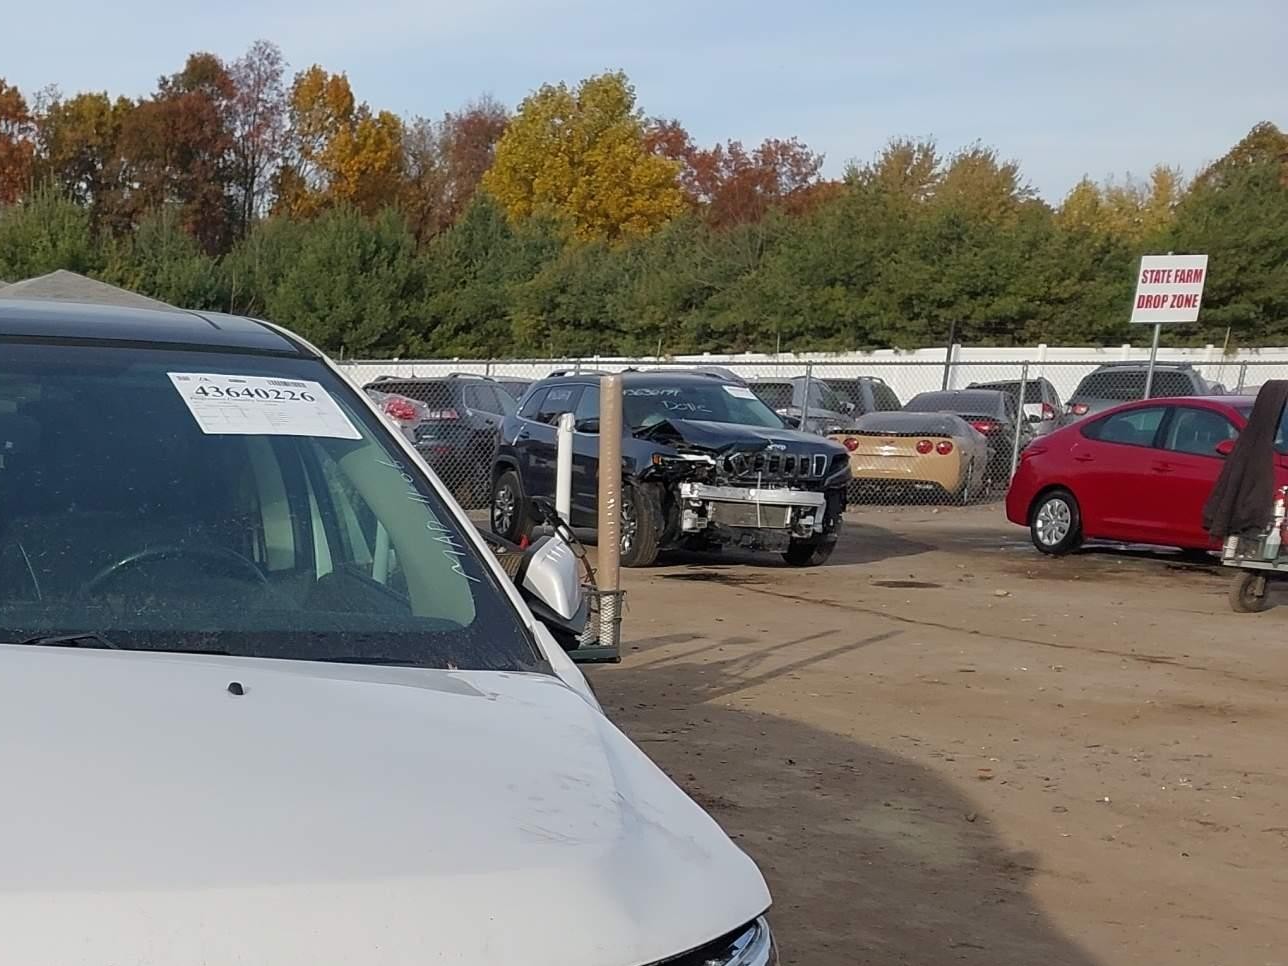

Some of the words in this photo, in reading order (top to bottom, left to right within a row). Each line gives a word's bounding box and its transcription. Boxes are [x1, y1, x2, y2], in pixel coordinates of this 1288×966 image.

[1141, 269, 1173, 284] STATE
[1173, 268, 1203, 284] FARM
[1137, 294, 1169, 309] DROP
[1169, 293, 1199, 309] ZONE
[195, 385, 315, 402] 43640226
